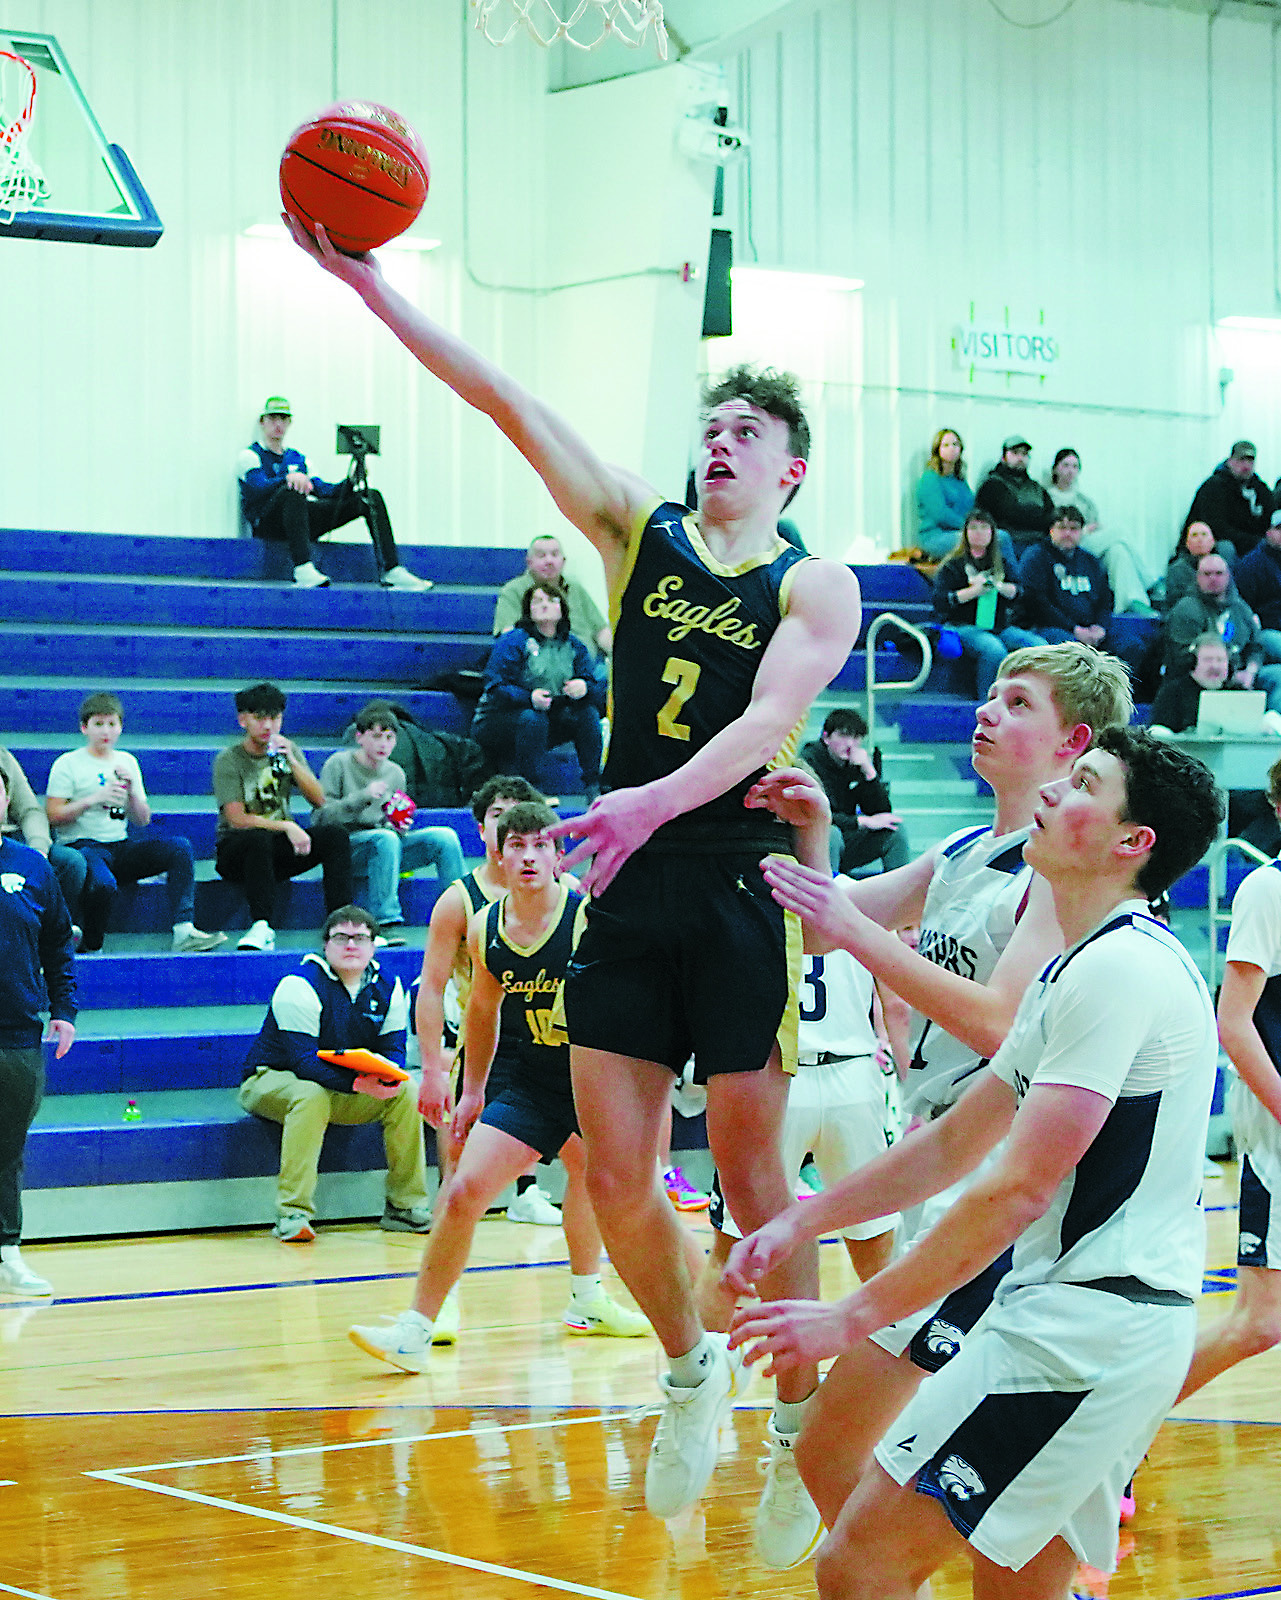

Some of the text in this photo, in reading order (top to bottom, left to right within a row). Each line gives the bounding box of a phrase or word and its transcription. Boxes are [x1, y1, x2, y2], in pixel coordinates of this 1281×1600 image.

[960, 332, 1055, 362] VISITORS
[643, 575, 761, 649] Eagles
[657, 657, 701, 741] 2
[501, 968, 560, 1002] Eagles
